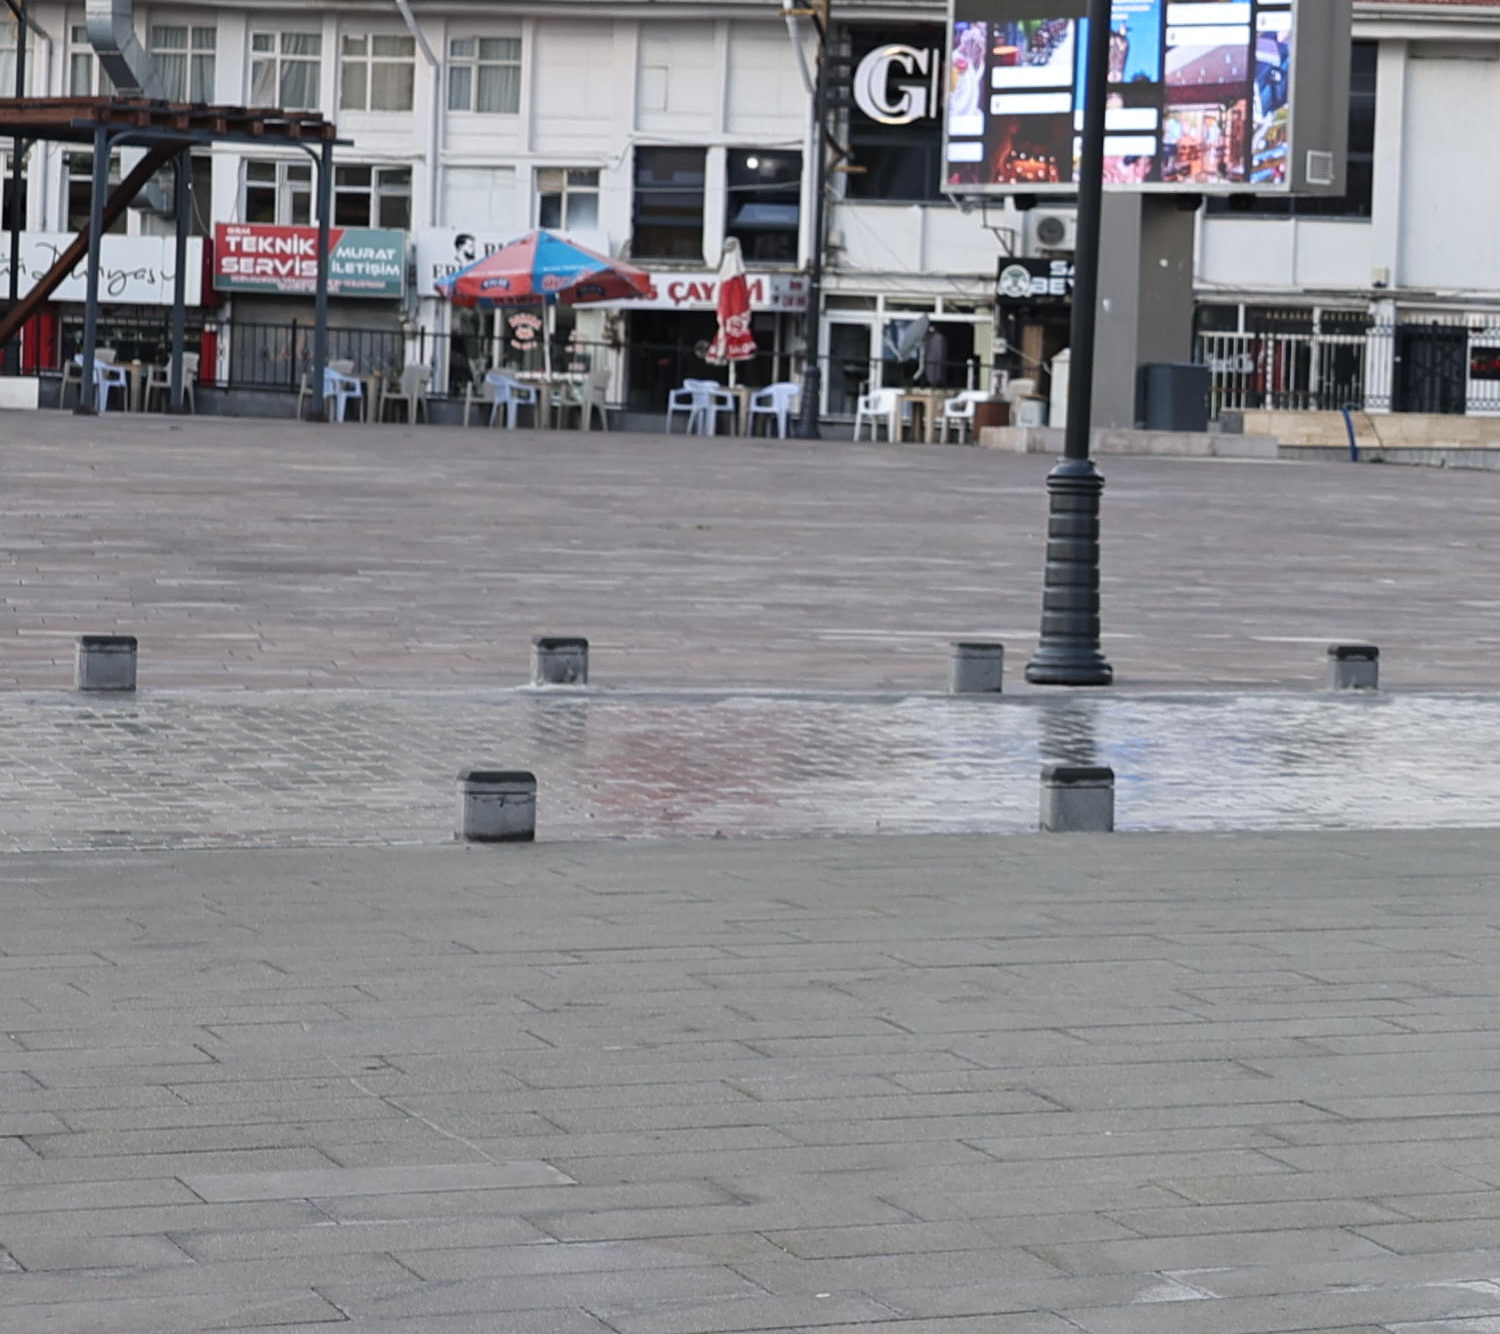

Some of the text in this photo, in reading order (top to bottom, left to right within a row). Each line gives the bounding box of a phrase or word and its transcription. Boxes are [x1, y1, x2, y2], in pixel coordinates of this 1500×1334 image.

[225, 233, 315, 256] TEKNİK
[335, 246, 396, 261] MURAT
[220, 255, 319, 277] SERVİS
[331, 259, 400, 279] İLETİŞİM
